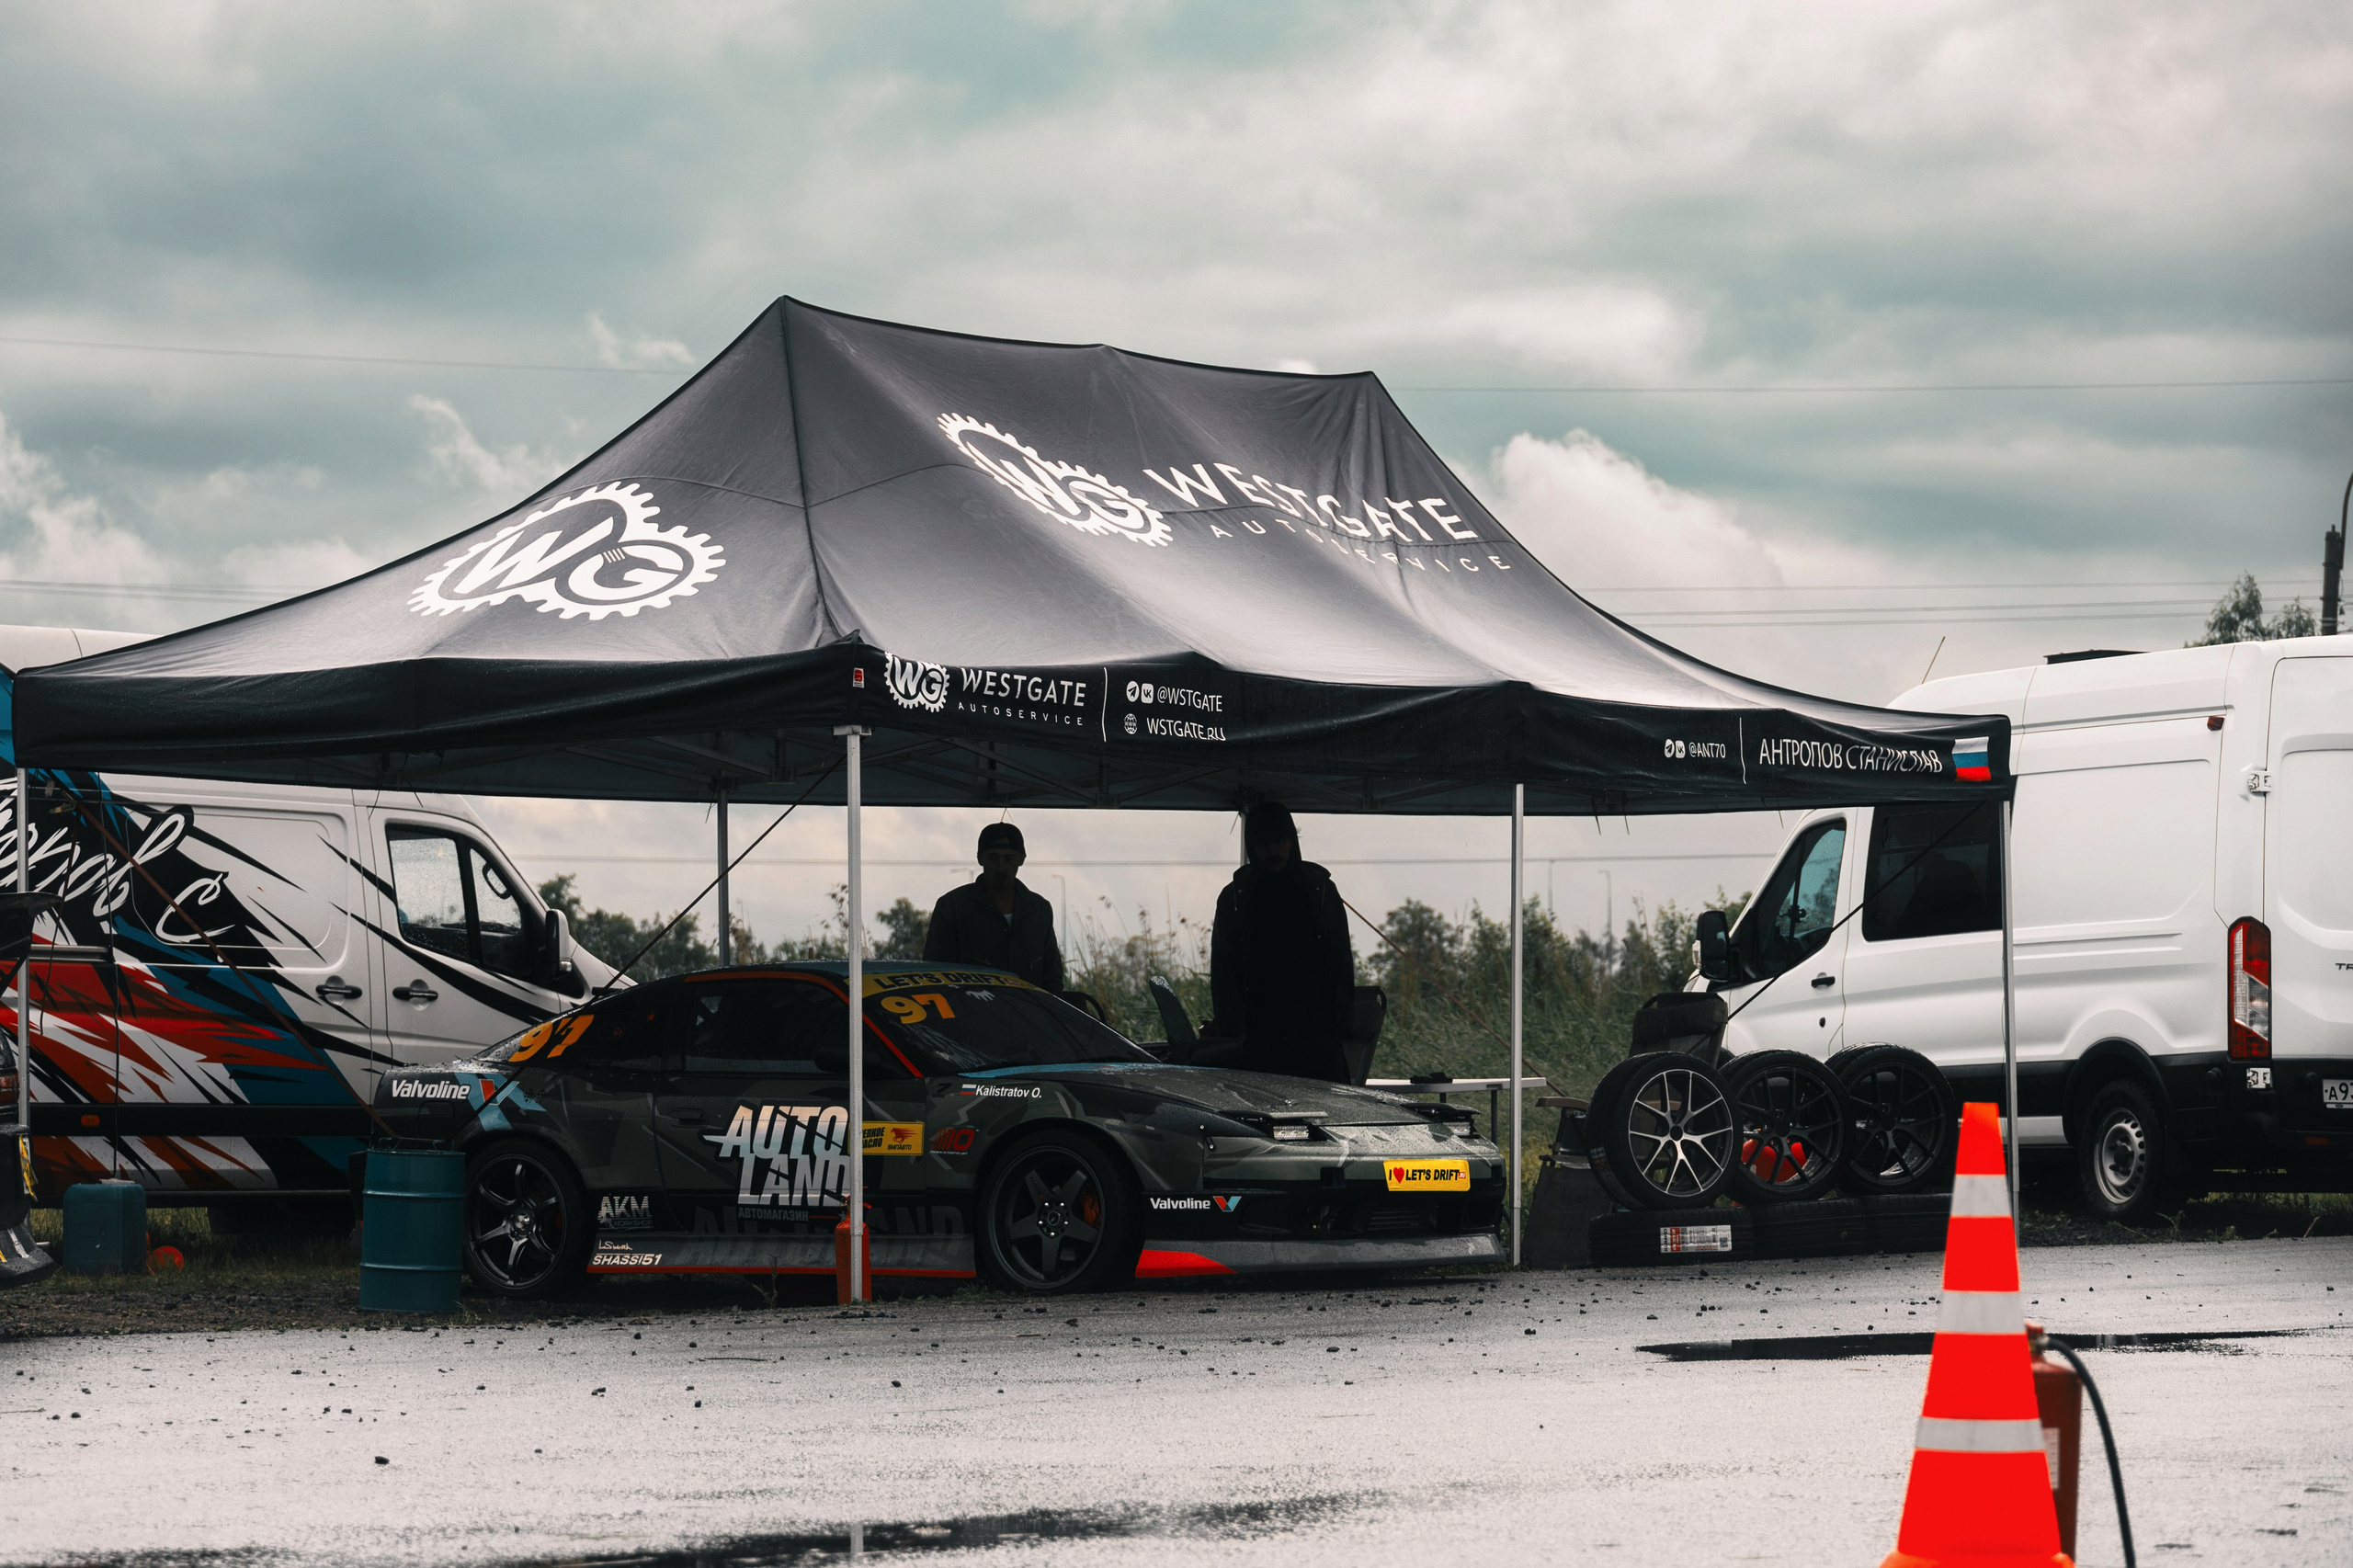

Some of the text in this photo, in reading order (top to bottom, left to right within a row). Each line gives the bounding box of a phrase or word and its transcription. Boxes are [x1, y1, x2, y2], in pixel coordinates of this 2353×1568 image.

[1142, 463, 1478, 542] WESTGATE
[1211, 518, 1511, 572] AUTOSERVICE
[961, 667, 1086, 707] WESTGATE
[1156, 686, 1223, 712] @WSTGATE
[958, 701, 1084, 726] AUTOSERVICE
[1146, 717, 1226, 741] WSTGATE.RU
[1688, 742, 1726, 758] @ANT70
[1759, 738, 1943, 773] АНТРОПОВ СТАНИСЛАВ
[874, 972, 944, 990] LET'S
[881, 993, 956, 1024] 97
[507, 1014, 595, 1062] 97
[392, 1080, 471, 1099] Valvoline
[975, 1085, 1042, 1098] Kalistratov O.
[702, 1105, 849, 1159] AUTO
[862, 1138, 883, 1149] АСЛО
[738, 1153, 851, 1207] LAND
[1389, 1169, 1392, 1181] I
[1405, 1169, 1431, 1181] LET'S
[597, 1196, 653, 1218] AKM
[738, 1207, 809, 1222] АВТОМАГАЗИН
[1150, 1198, 1211, 1210] Valvoline
